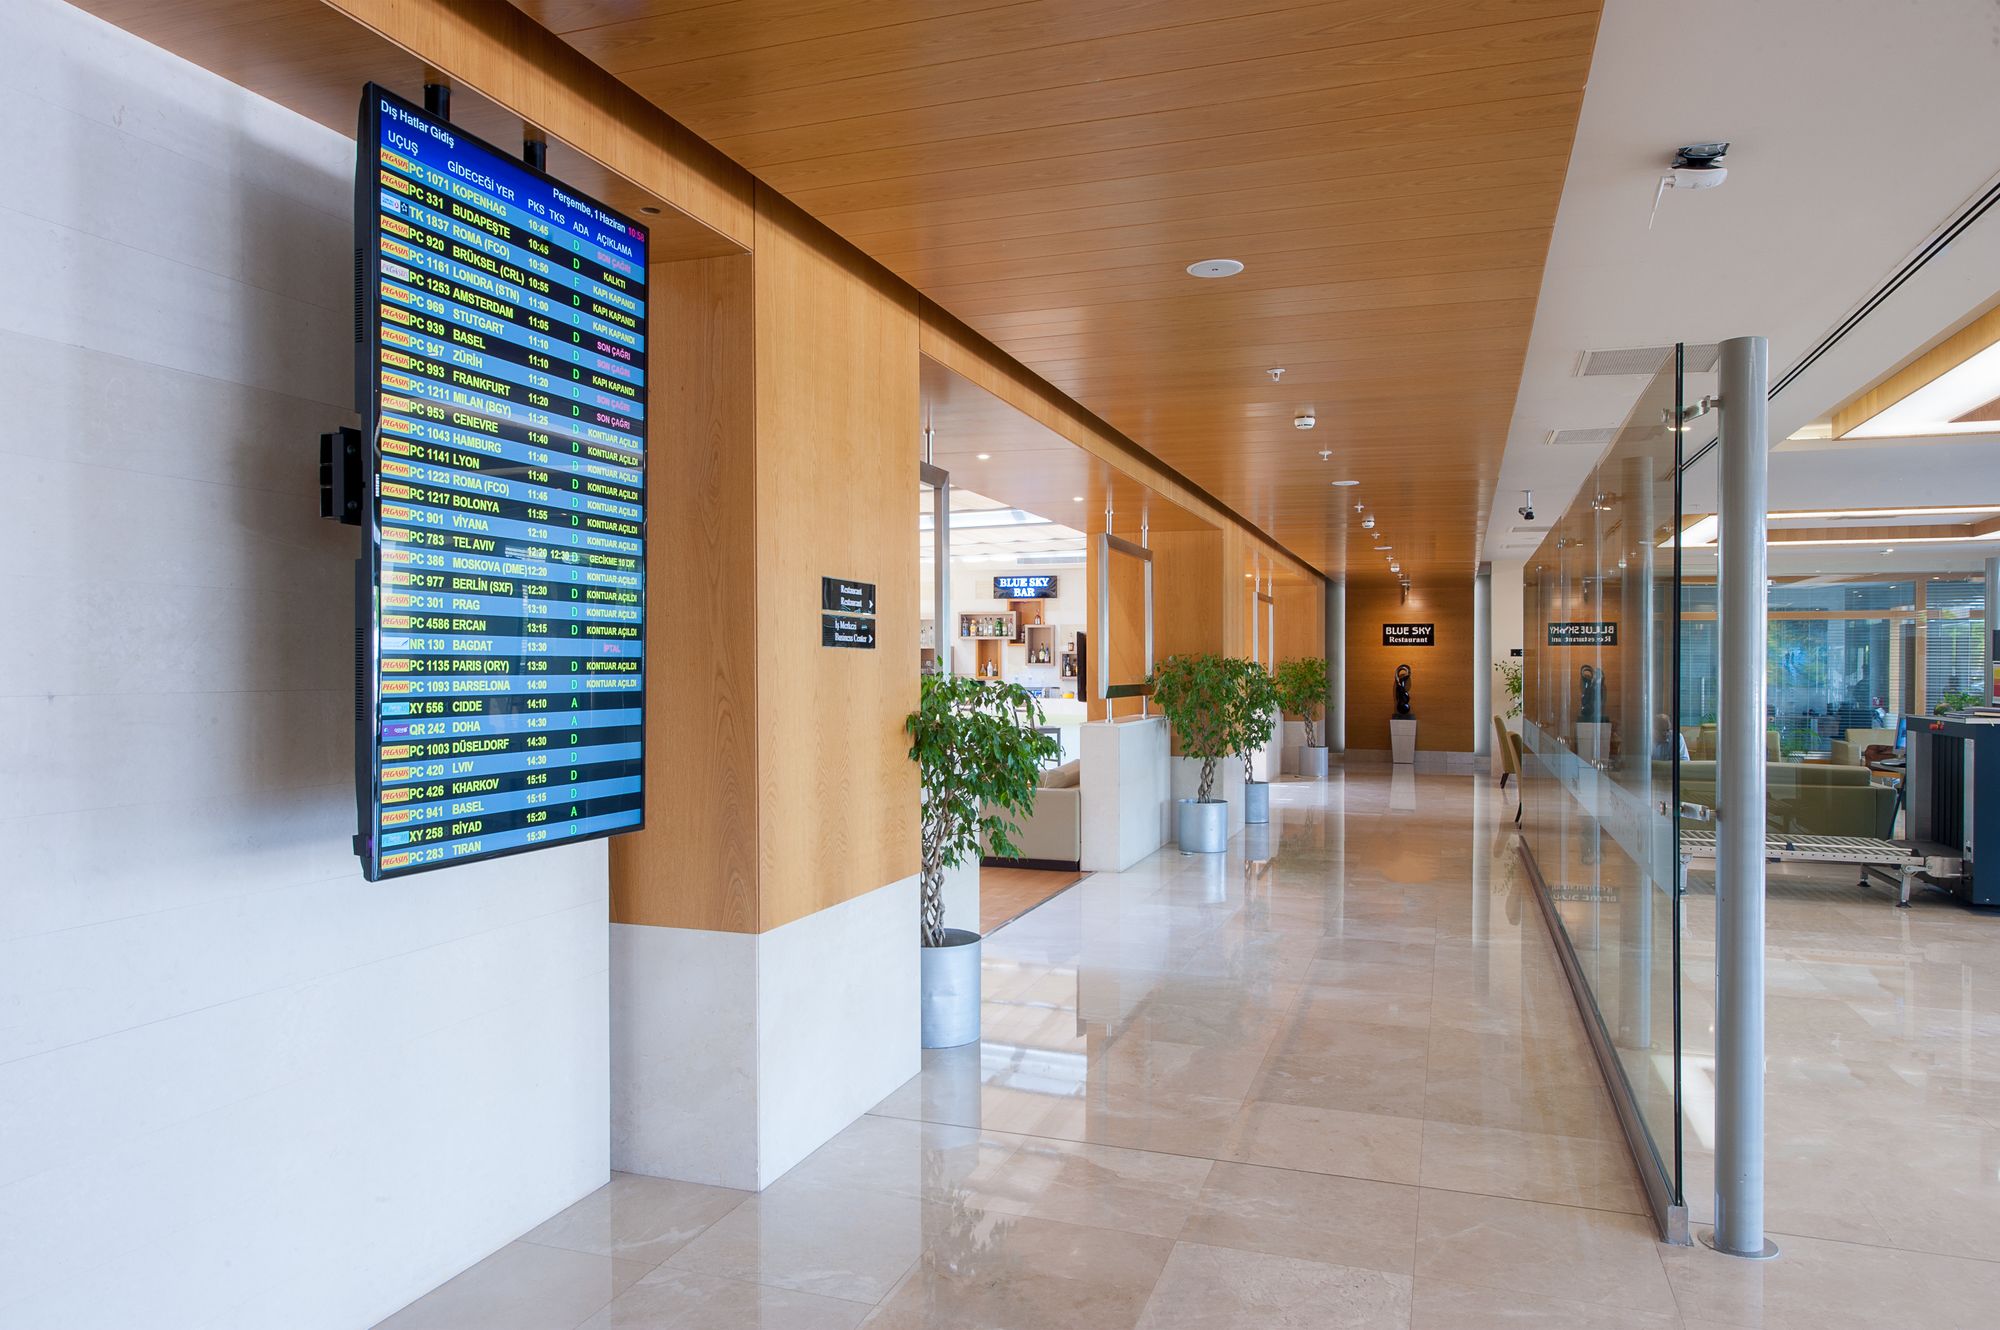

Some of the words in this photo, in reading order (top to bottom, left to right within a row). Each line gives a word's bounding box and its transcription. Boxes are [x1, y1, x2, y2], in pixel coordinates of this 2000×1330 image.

[381, 99, 397, 120] Dış
[399, 109, 428, 132] Hatlar
[430, 125, 454, 148] Gidiş
[388, 130, 418, 156] UÇUŞ
[447, 160, 494, 191] GİDECEĞİ
[496, 183, 514, 200] YER
[528, 198, 544, 214] PKS
[549, 208, 565, 224] TKS
[572, 221, 589, 236] ADA
[596, 232, 632, 257] AÇIKLAMA
[409, 162, 423, 178] PC
[426, 171, 448, 190] 1071
[452, 183, 506, 216] KOPENHAG
[553, 187, 593, 218] Perşembe,
[594, 209, 598, 219] 1
[599, 211, 625, 233] Haziran
[628, 227, 644, 241] 10:58
[409, 205, 423, 221] TK
[426, 214, 449, 231] 1837
[453, 224, 482, 246] ROMA
[484, 238, 509, 259] (FCO)
[409, 184, 423, 199] PC
[426, 192, 442, 208] 331
[452, 203, 510, 238] BUDAPEŞTE
[528, 238, 548, 254] 10:45
[603, 272, 625, 288] KALKTI
[409, 249, 424, 264] PC
[426, 256, 448, 274] 1161
[453, 266, 493, 291] LONDRA
[495, 283, 519, 302] (STN)
[409, 227, 423, 242] PC
[426, 235, 444, 250] 920
[452, 245, 498, 273] BRÜKSEL
[500, 264, 524, 285] (CRL)
[528, 277, 548, 292] 10:55
[592, 303, 607, 316] KAPI
[608, 309, 635, 327] KAPANDI
[409, 271, 423, 286] PC
[426, 278, 450, 295] 1253
[452, 287, 513, 318] AMSTERDAM
[409, 292, 424, 307] PC
[426, 299, 444, 314] 969
[452, 308, 504, 334] STUTGART
[409, 314, 424, 328] PC
[426, 320, 444, 335] 939
[453, 328, 485, 349] BASEL
[528, 354, 548, 368] 11:10
[409, 336, 424, 350] PC
[426, 342, 444, 356] 947
[452, 349, 482, 368] ZÜRİH
[409, 357, 424, 371] PC
[426, 363, 444, 377] 993
[453, 370, 510, 396] FRANKFURT
[596, 413, 610, 423] SON
[409, 379, 424, 393] PC
[427, 384, 448, 400] 1211
[485, 400, 511, 418] (BGY)
[409, 399, 424, 414] PC
[426, 405, 444, 419] 953
[453, 412, 498, 432] CENEVRE
[409, 422, 424, 436] PC
[427, 427, 449, 441] 1043
[453, 433, 501, 452] HAMBURG
[409, 444, 424, 457] PC
[427, 448, 448, 462] 1141
[453, 453, 479, 468] LYON
[408, 466, 424, 479] PC
[427, 470, 449, 483] 1223
[452, 474, 482, 489] ROMA
[484, 480, 509, 496] (FCO)
[408, 487, 424, 500] PC
[427, 490, 450, 504] 1217
[452, 494, 499, 512] BOLONYA
[587, 518, 617, 530] KONTUAR
[408, 509, 424, 521] PC
[426, 512, 442, 524] 901
[452, 514, 488, 530] VİYANA
[409, 530, 424, 543] PC
[426, 533, 444, 545] 783
[452, 536, 471, 548] TEL
[472, 538, 494, 551] AVIV
[408, 552, 424, 564] PC
[427, 554, 444, 566] 386
[452, 557, 500, 571] MOSKOVA
[408, 573, 424, 585] PC
[426, 575, 444, 587] 977
[452, 577, 487, 590] BERLİN
[489, 581, 512, 595] (SXF)
[527, 584, 547, 595] 12:30
[1000, 578, 1028, 587] BLUE
[1029, 578, 1049, 587] SKY
[1014, 588, 1035, 597] BAR
[408, 594, 424, 607] PC
[426, 596, 442, 608] 301
[453, 598, 479, 610] PRAG
[408, 616, 424, 628] PC
[426, 618, 449, 629] 4586
[452, 618, 485, 630] ERCAN
[586, 626, 616, 635] KONTUAR
[1386, 626, 1409, 635] BLUE
[1412, 626, 1431, 635] SKY
[408, 638, 424, 649] NR
[427, 639, 444, 650] 130
[408, 659, 424, 671] PC
[426, 660, 449, 670] 1135
[483, 660, 509, 673] (ORY)
[408, 681, 424, 692] PC
[427, 680, 449, 691] 1093
[452, 680, 510, 691] BARSELONA
[409, 702, 423, 714] XY
[426, 702, 443, 713] 556
[527, 698, 546, 708] 14:10
[409, 723, 425, 734] QR
[427, 722, 444, 734] 242
[452, 720, 480, 732] DOHA
[408, 744, 423, 757] PC
[426, 743, 449, 755] 1003
[452, 738, 509, 753] DÜSELDORF
[526, 736, 546, 746] 14:30
[408, 766, 423, 778] PC
[426, 764, 444, 775] 420
[452, 761, 473, 773] LVIV
[408, 787, 423, 799] PC
[426, 785, 444, 797] 426
[452, 778, 499, 793] KHARKOV
[408, 808, 423, 821] PC
[426, 806, 442, 818] 941
[452, 801, 484, 814] BASEL
[409, 829, 423, 842] XY
[425, 826, 442, 839] 258
[452, 820, 481, 835] RİYAD
[526, 810, 546, 822] 15:20
[408, 850, 423, 864] PC
[426, 847, 443, 860] 283
